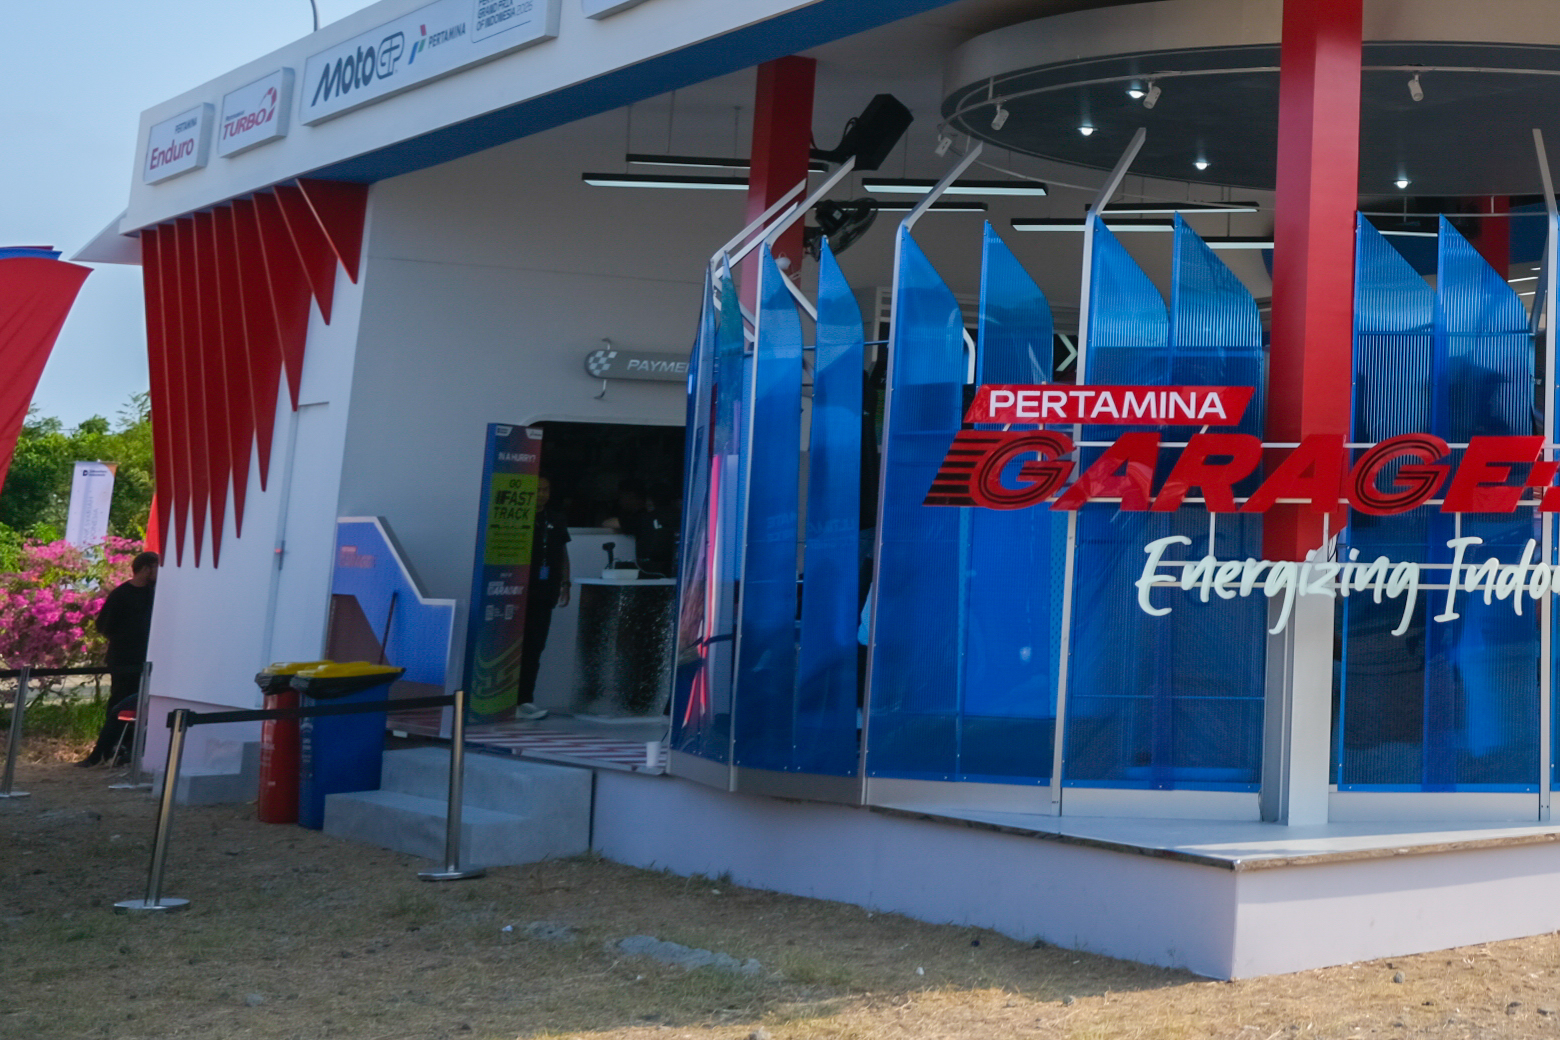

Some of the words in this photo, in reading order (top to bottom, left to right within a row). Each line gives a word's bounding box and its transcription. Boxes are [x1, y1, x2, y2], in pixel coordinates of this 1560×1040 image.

[428, 22, 466, 49] PERTAMINA
[310, 30, 405, 107] MotoGP
[223, 108, 267, 141] TURBO
[149, 138, 194, 170] Enduro
[626, 359, 689, 374] PAYME
[989, 390, 1228, 420] PERTAMINA
[509, 478, 522, 488] GO
[922, 429, 1548, 516] GARAGE
[493, 506, 530, 520] TRACK
[499, 490, 535, 506] FAST
[1135, 535, 1419, 636] Energizing
